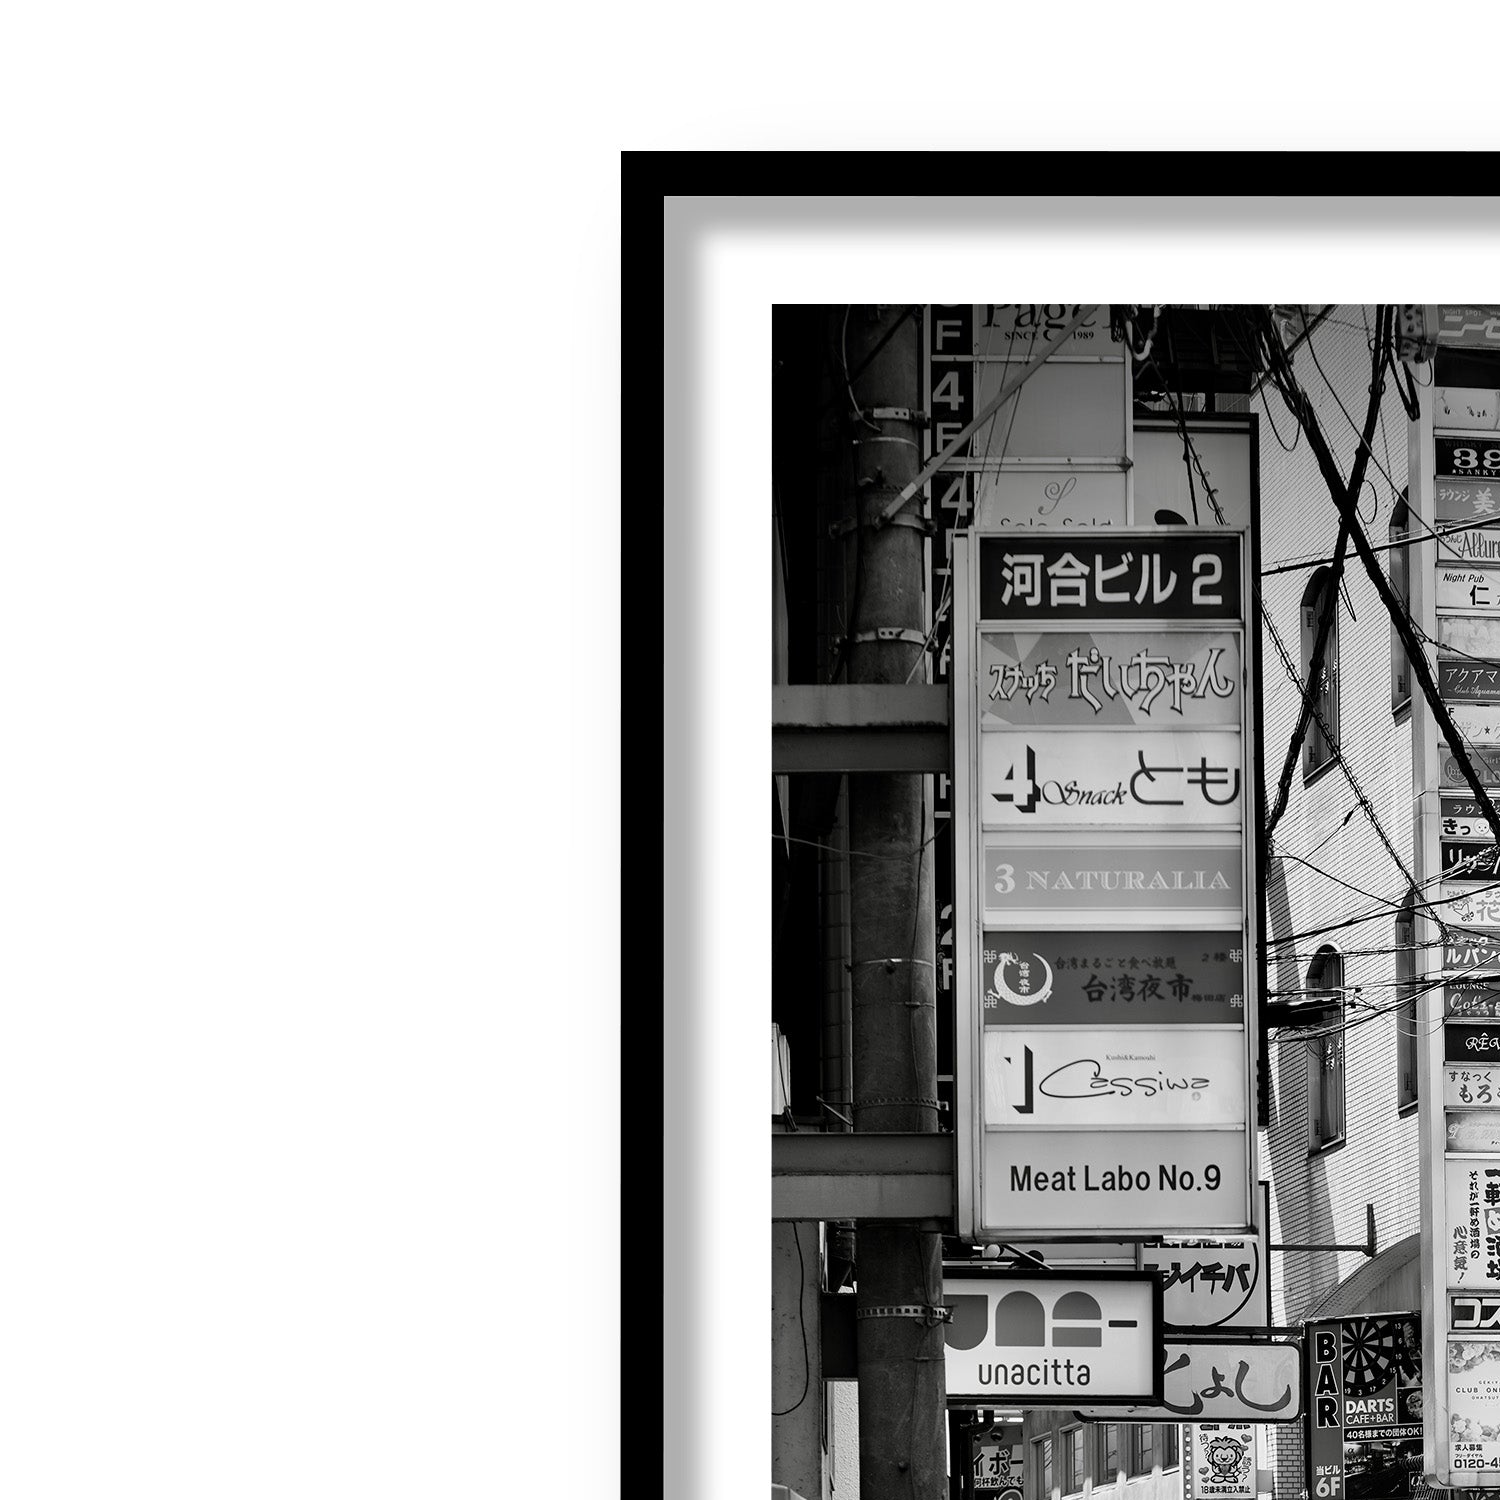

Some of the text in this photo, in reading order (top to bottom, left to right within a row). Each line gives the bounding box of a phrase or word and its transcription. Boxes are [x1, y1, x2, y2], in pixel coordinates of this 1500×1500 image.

[1439, 488, 1471, 502] ラウンジ
[1001, 552, 1222, 607] 河合ビル 2
[1443, 573, 1485, 584] Night Pub
[1469, 584, 1490, 606] 仁
[1066, 647, 1235, 715] だいちゃん
[991, 744, 1041, 813] 4
[1042, 780, 1127, 806] Snack
[1130, 750, 1240, 805] とも
[994, 863, 1231, 893] 3 NATURALIA
[1081, 973, 1193, 1003] 台湾夜市
[1449, 1071, 1492, 1082] すなっく
[1010, 1164, 1221, 1192] Meat Labo No.9
[978, 1359, 1091, 1386] unacitta
[1346, 1398, 1395, 1415] DARTS
[1346, 1427, 1423, 1440] 40名様までの団体OK!
[1316, 1465, 1341, 1476] 当ビル
[1316, 1476, 1341, 1498] 6F
